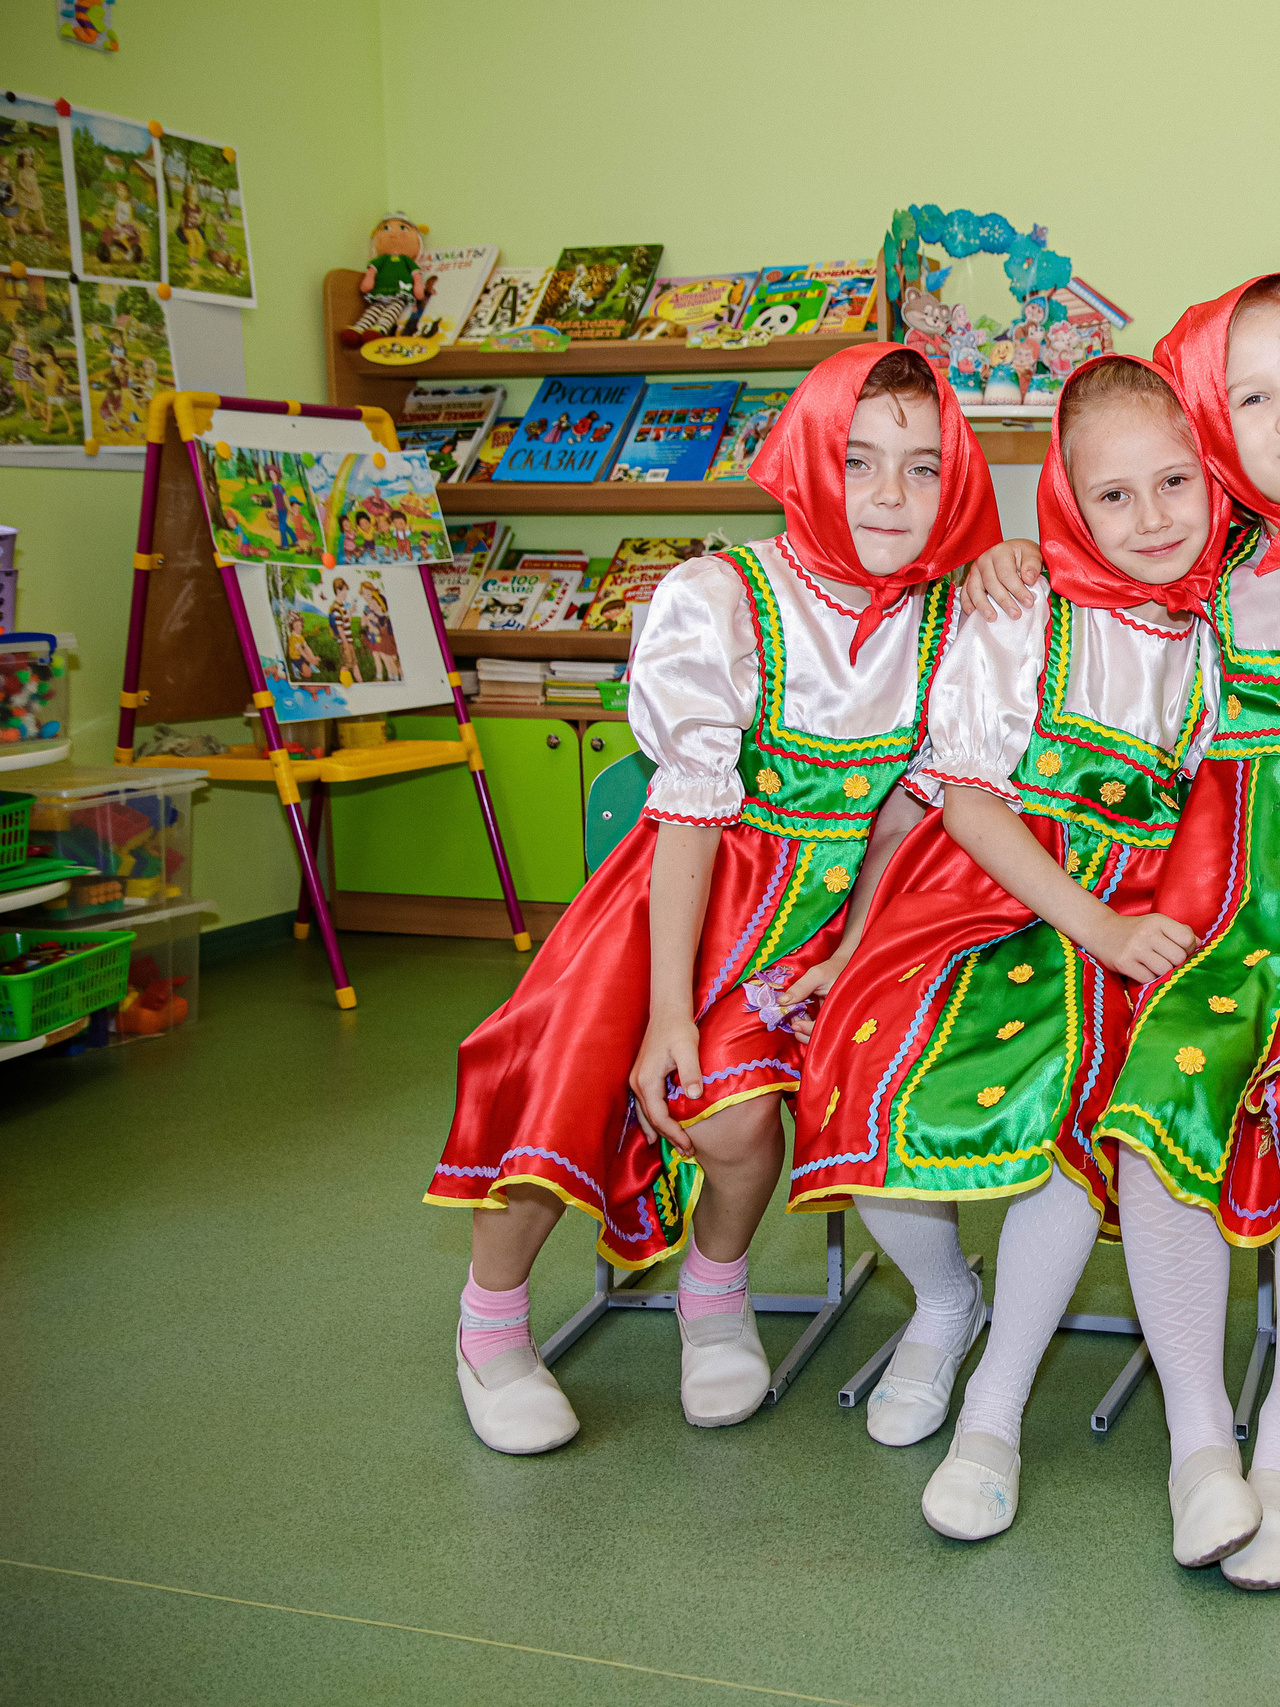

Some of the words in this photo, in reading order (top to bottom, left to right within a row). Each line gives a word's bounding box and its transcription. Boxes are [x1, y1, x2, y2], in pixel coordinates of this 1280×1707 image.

[758, 289, 824, 304] ЖИВОТНЫЕ
[542, 380, 631, 405] РУССКИЕ
[508, 449, 598, 471] СКАЗКИ
[511, 575, 539, 585] 100
